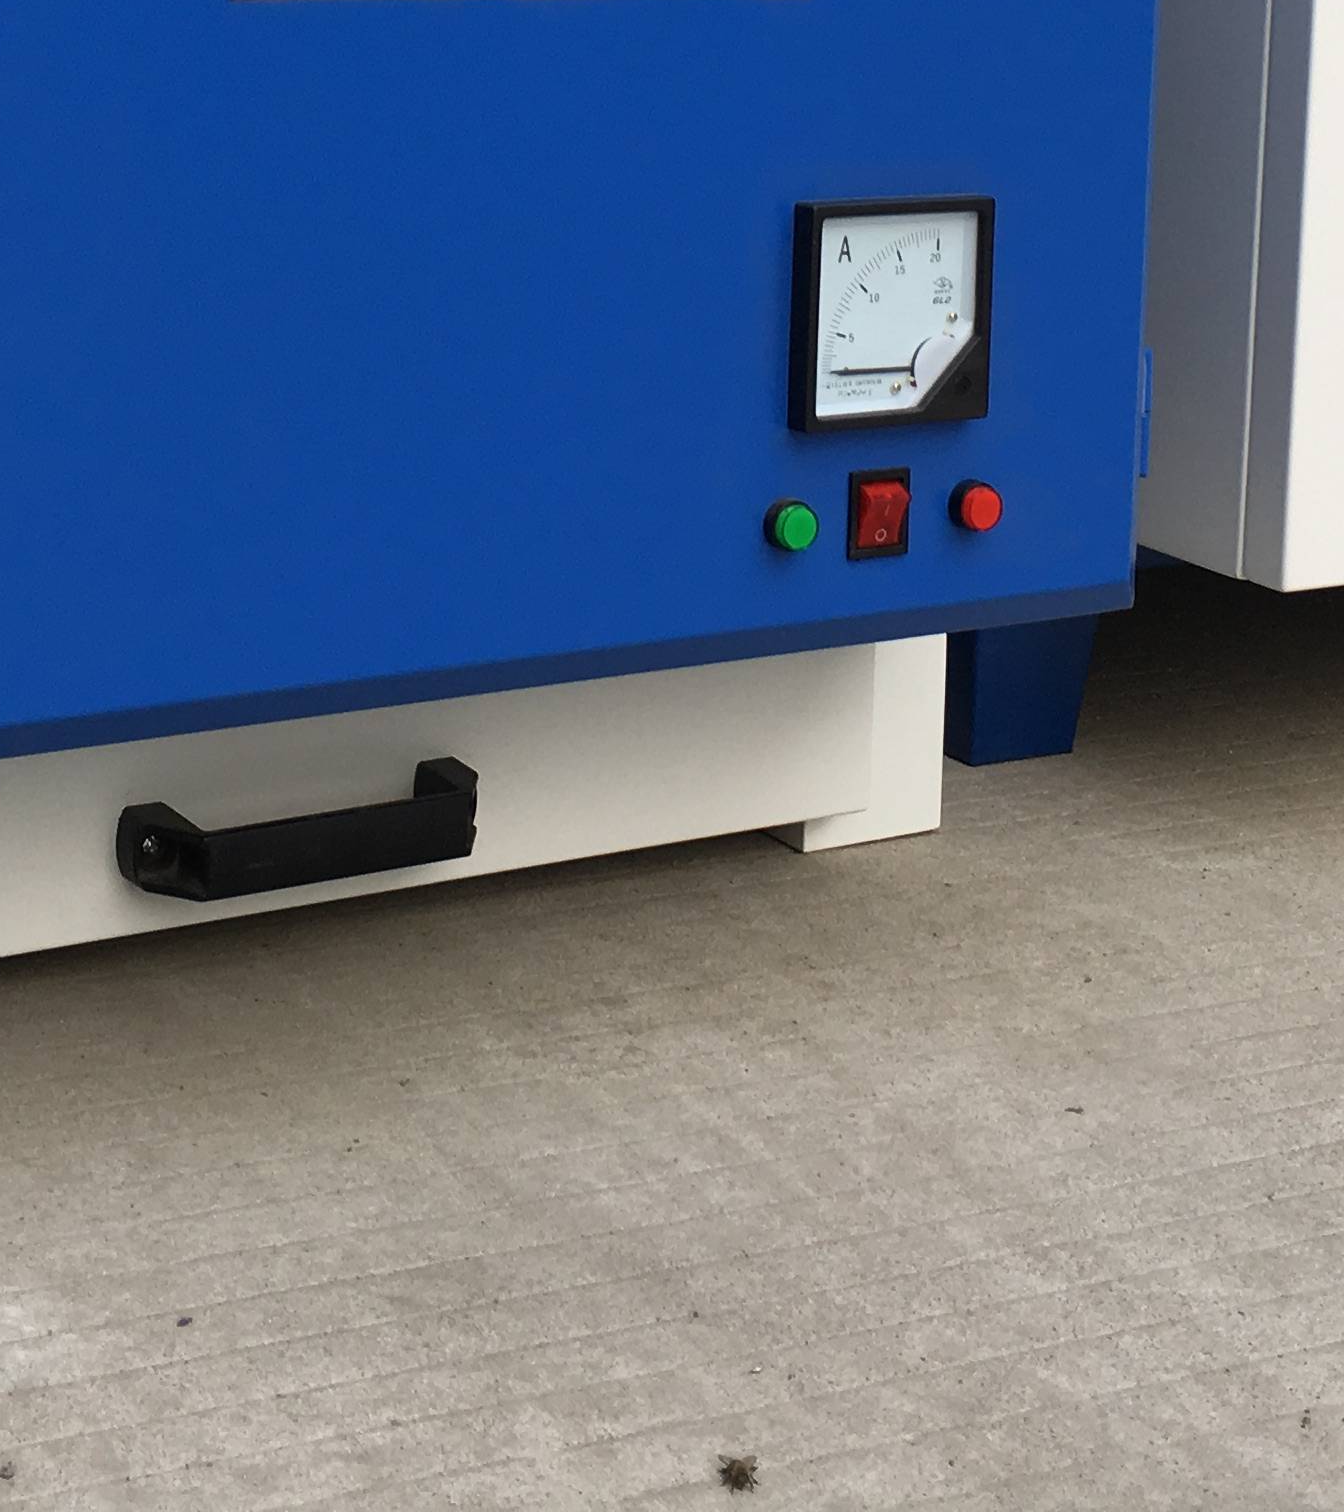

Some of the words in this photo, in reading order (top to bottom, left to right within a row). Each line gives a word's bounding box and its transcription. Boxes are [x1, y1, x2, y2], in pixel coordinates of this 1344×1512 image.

[838, 235, 852, 263] A
[929, 253, 942, 263] 20
[869, 292, 880, 304] 10
[848, 333, 855, 343] 5
